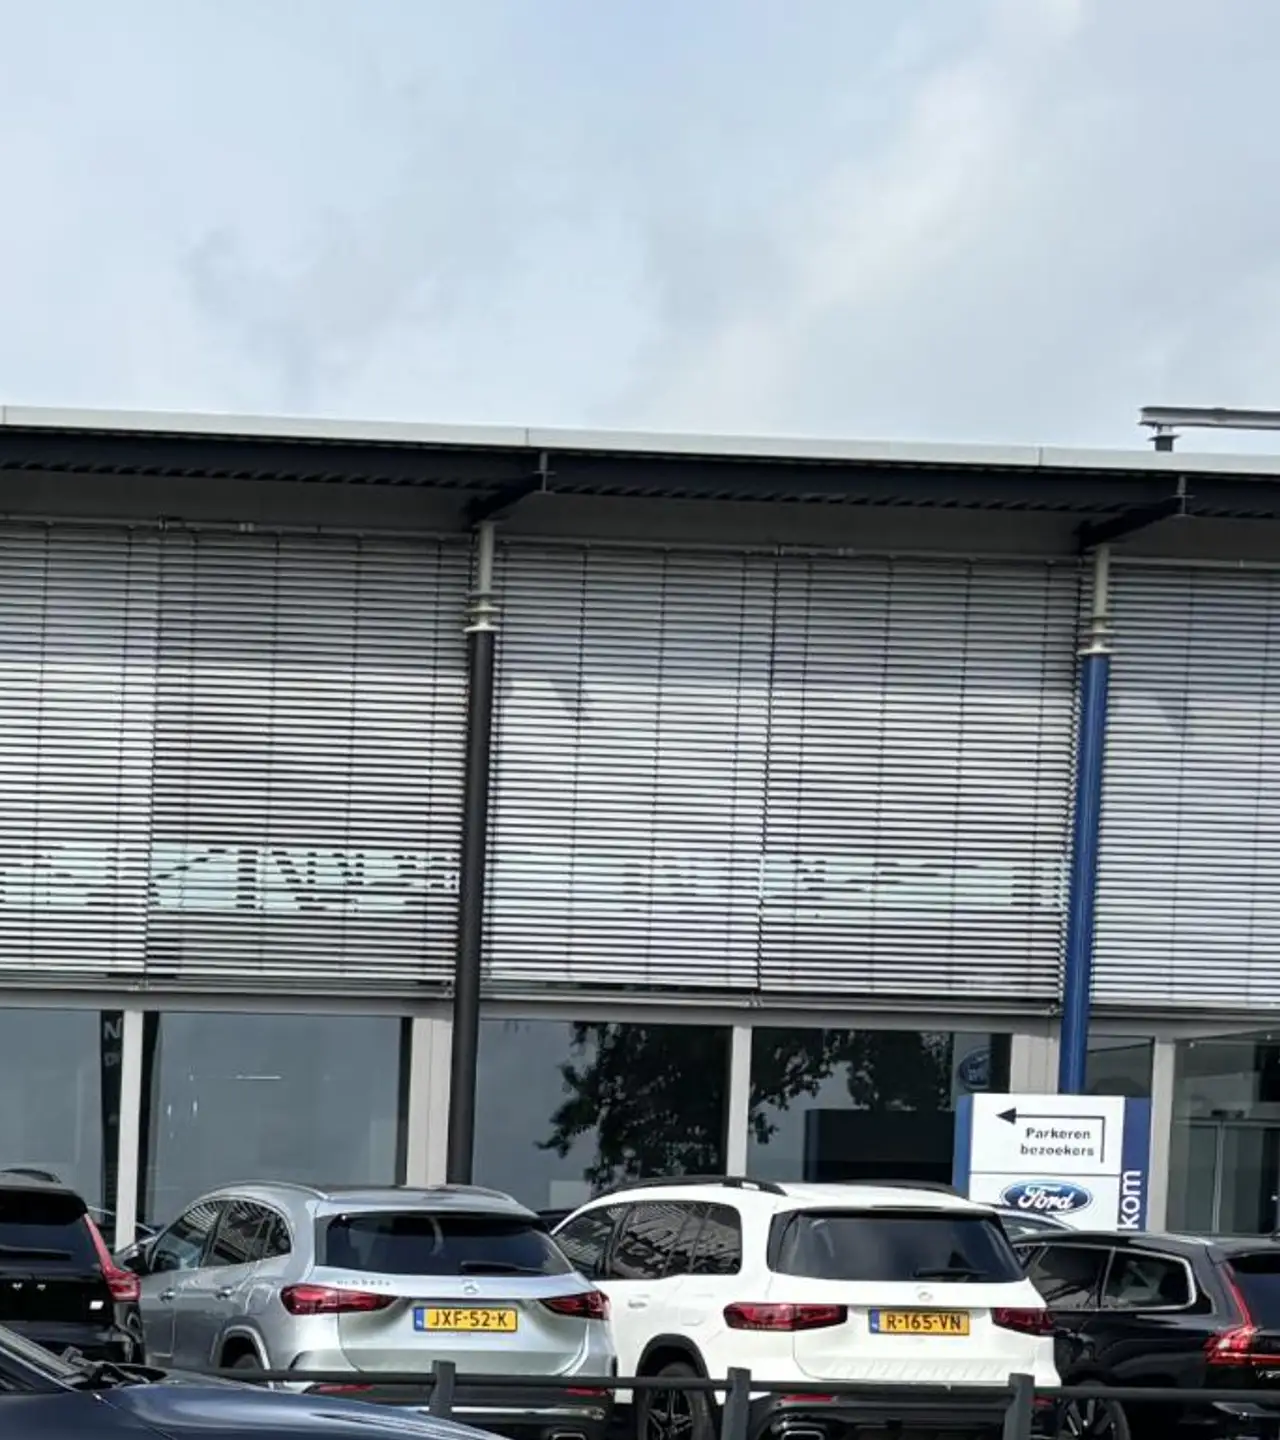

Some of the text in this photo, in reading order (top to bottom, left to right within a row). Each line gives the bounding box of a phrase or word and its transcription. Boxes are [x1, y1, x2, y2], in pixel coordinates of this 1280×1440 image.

[1025, 1127, 1091, 1140] Parkeren
[1020, 1143, 1095, 1157] bezoekers
[1017, 1184, 1075, 1210] Ford
[431, 1308, 509, 1327] JXF-52-K
[886, 1313, 962, 1331] R-165-VN
